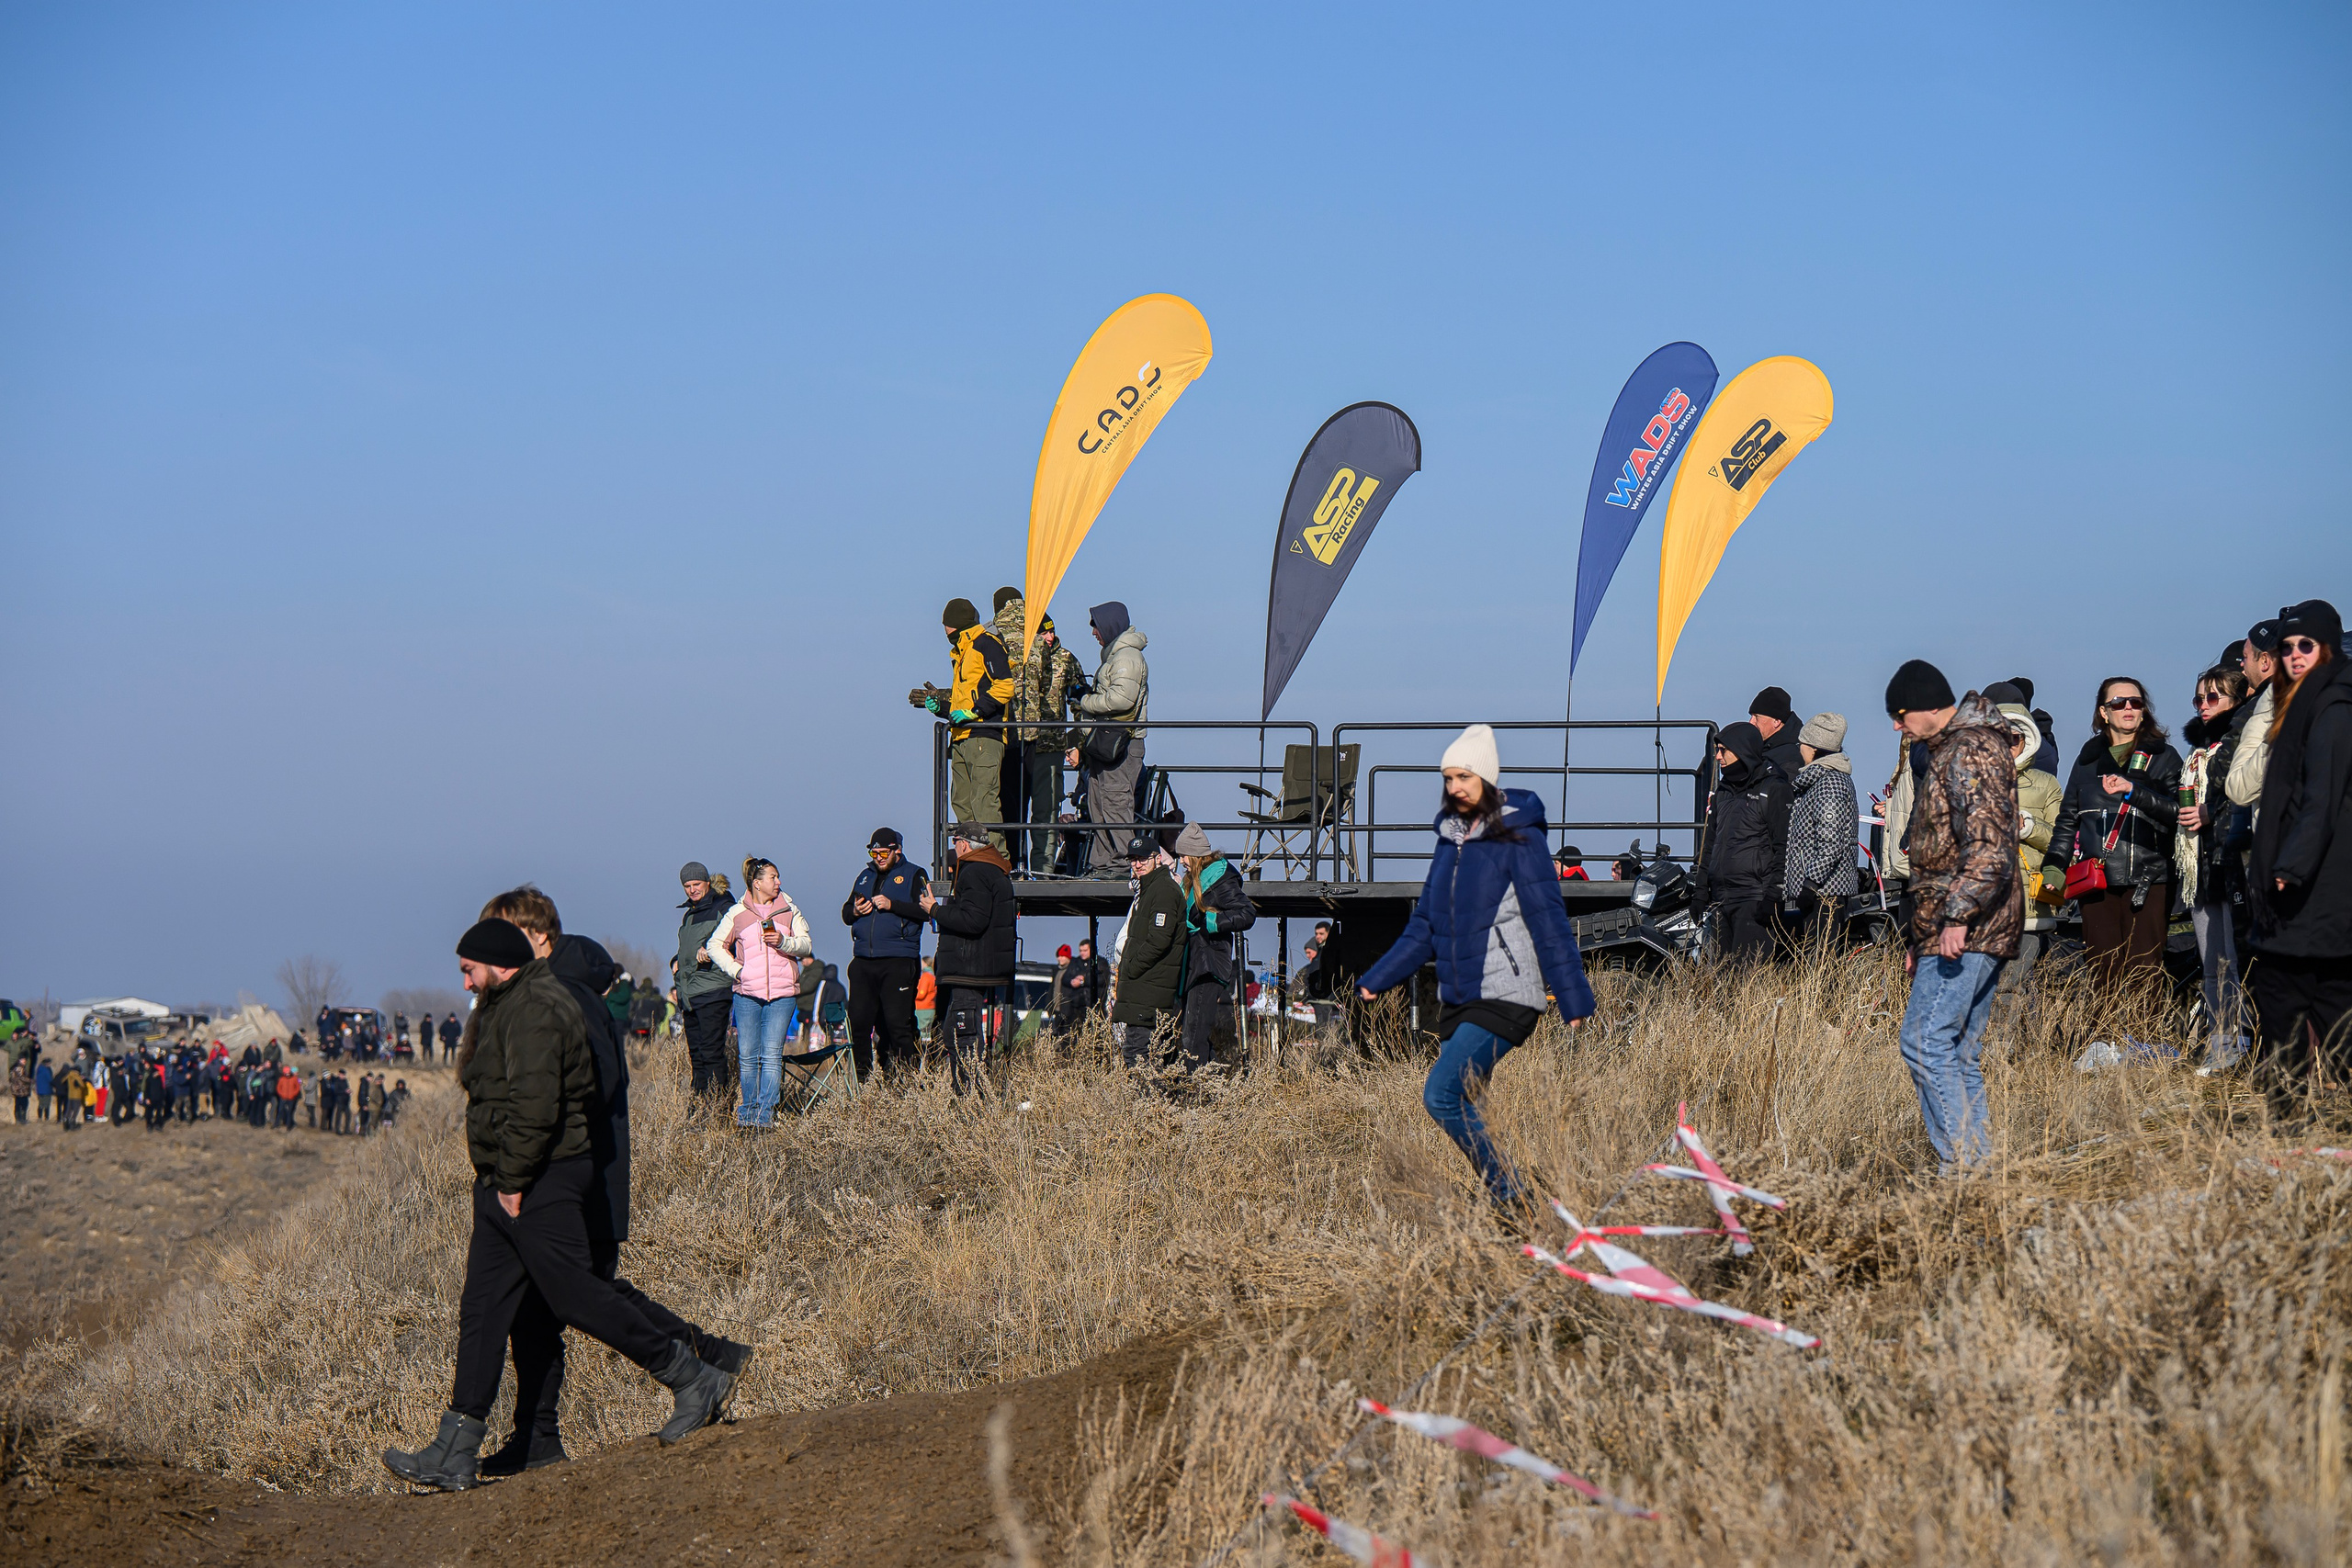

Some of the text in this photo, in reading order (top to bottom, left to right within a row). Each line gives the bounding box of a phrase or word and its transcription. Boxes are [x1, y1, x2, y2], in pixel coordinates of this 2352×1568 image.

[1078, 360, 1161, 455] CADS
[1102, 384, 1162, 454] CENTRAL ASIA DRIFT SHOW
[1604, 387, 1690, 508] WADS
[1630, 405, 1698, 511] WINTER ASIA DRIFT SHOW
[1720, 418, 1772, 484] ASP
[1747, 450, 1767, 470] Club
[1302, 468, 1356, 559] ASP
[1331, 496, 1365, 545] Racing
